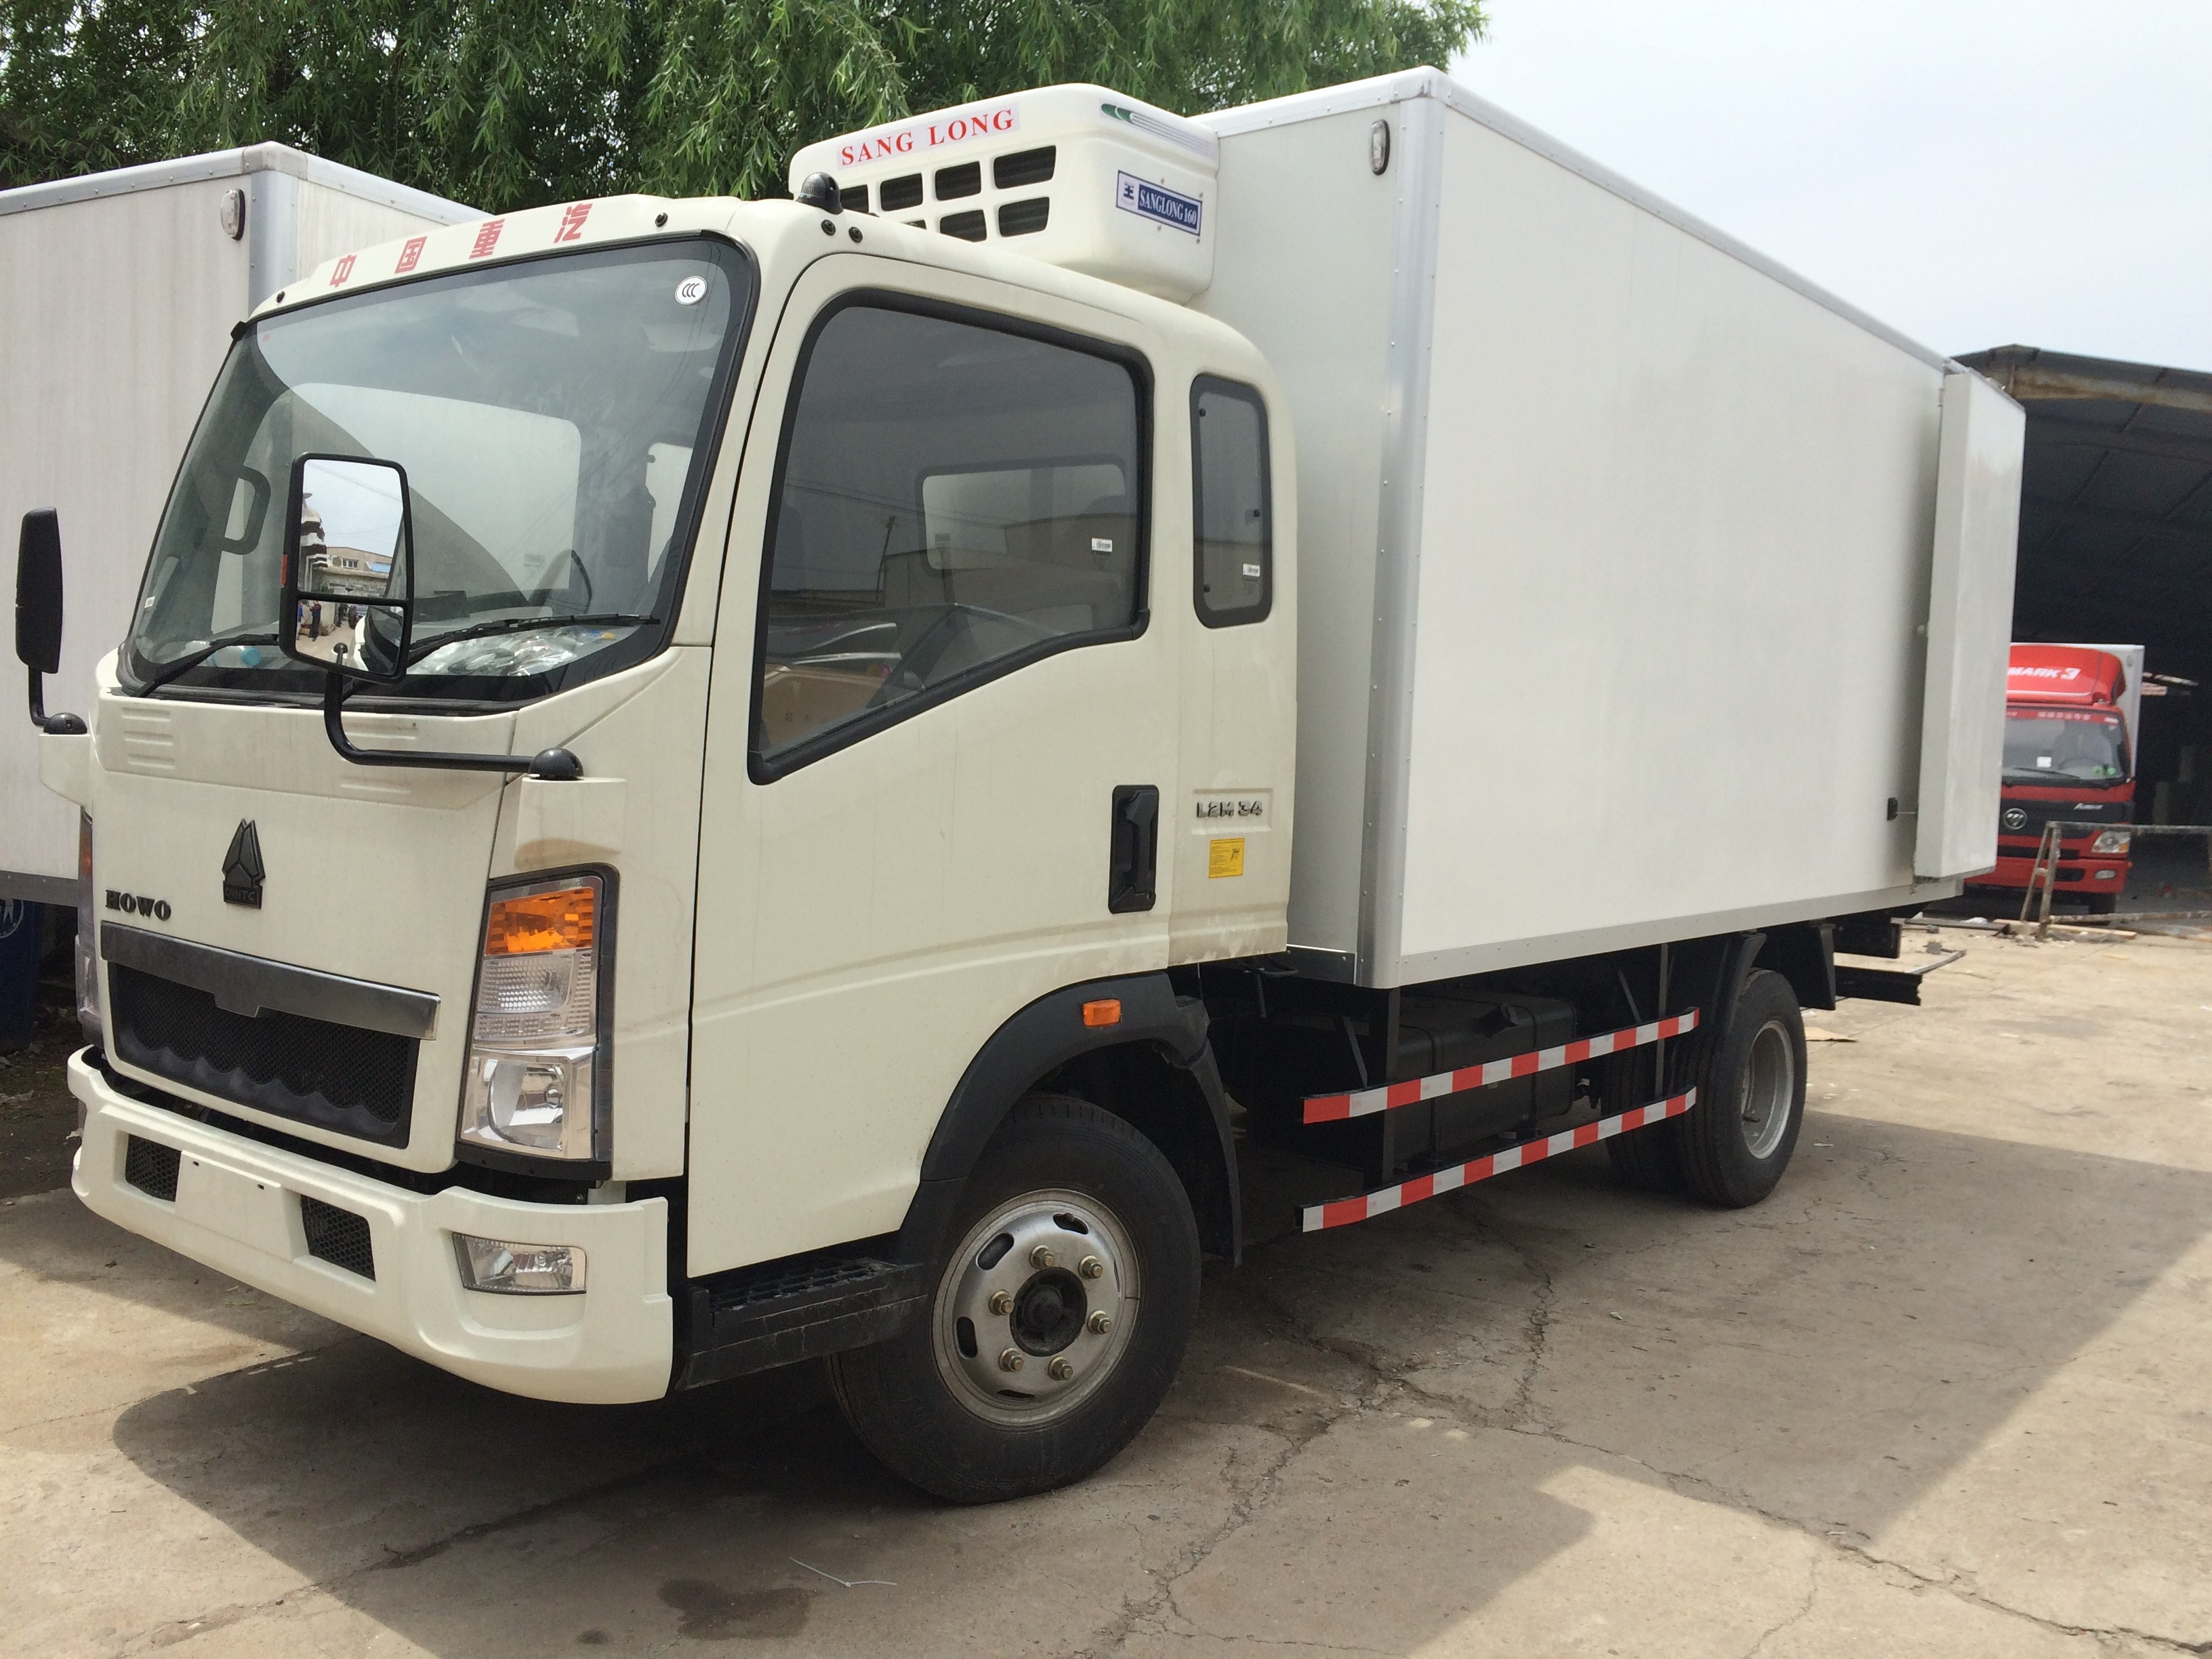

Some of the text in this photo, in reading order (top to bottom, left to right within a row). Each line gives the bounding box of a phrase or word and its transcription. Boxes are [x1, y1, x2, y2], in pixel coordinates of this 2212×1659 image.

[842, 108, 1013, 165] SANG LONG
[1140, 189, 1197, 225] SANGLONG 160
[329, 203, 593, 287] 中国重汽
[2061, 668, 2081, 680] 3
[105, 889, 171, 921] HOWO
